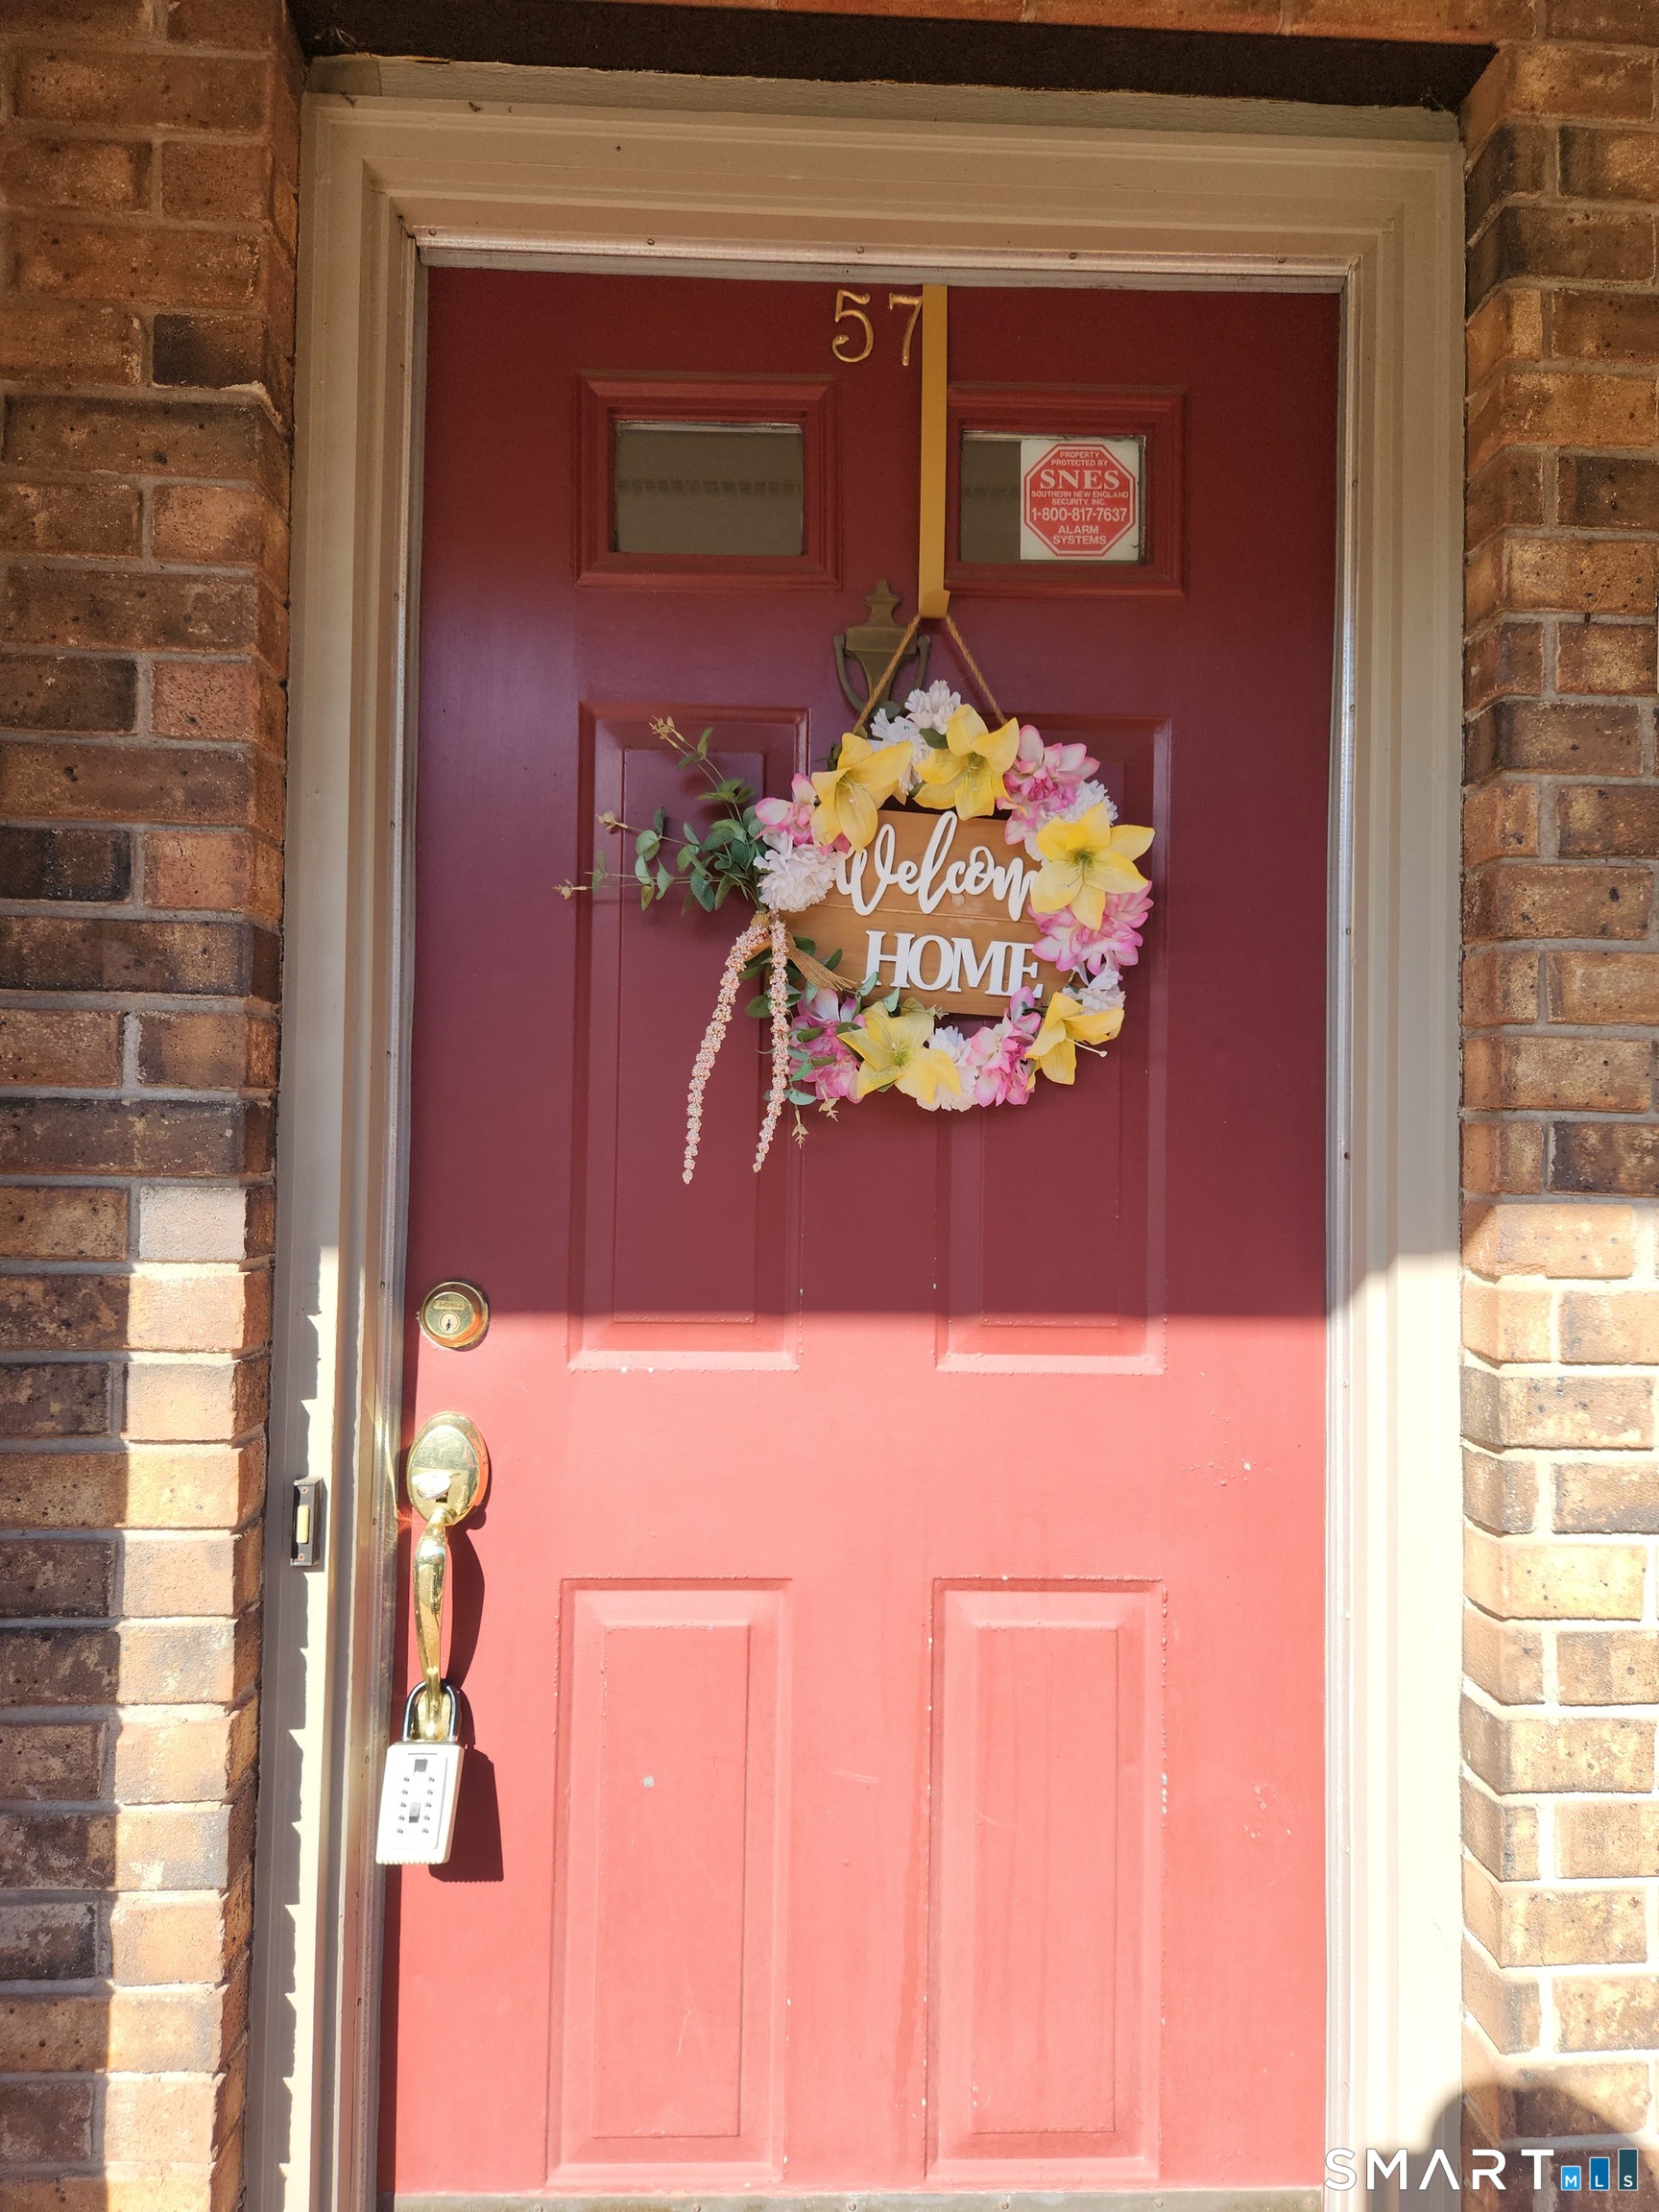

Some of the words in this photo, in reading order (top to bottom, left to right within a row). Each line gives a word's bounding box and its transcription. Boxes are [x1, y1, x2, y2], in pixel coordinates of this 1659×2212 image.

[831, 289, 923, 367] 57
[1040, 469, 1119, 490] SNES
[1031, 507, 1127, 521] 1-800-817-7637
[1052, 535, 1107, 545] SYSTEMS
[1058, 525, 1099, 535] ALARM
[836, 811, 1039, 922] Welcom
[861, 929, 1044, 998] HOME
